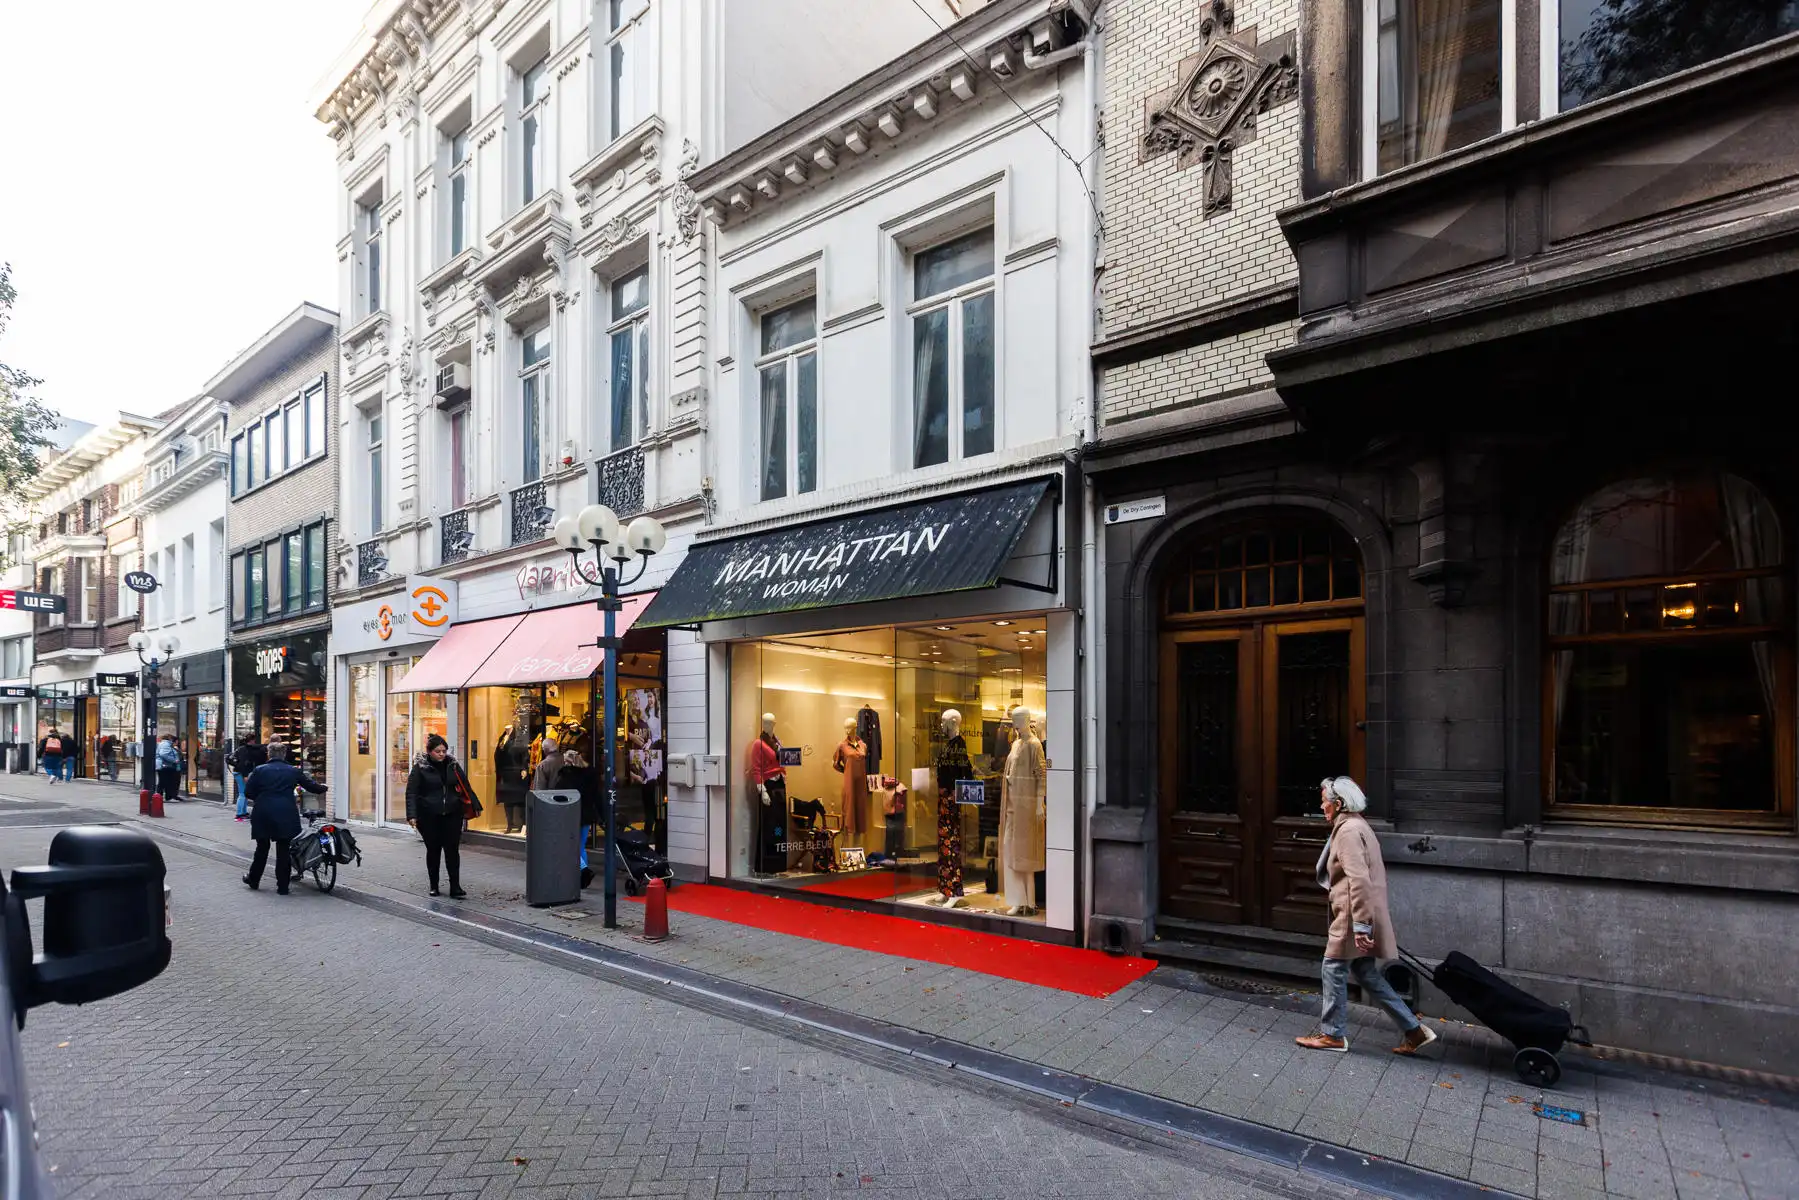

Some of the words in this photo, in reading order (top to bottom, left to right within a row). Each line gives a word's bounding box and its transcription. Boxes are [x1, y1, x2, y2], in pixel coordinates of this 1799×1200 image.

[714, 523, 951, 587] MANHATTAN
[129, 575, 153, 587] ms
[516, 552, 597, 601] paprika
[762, 573, 849, 599] WOMAN
[24, 596, 54, 609] WE
[363, 618, 379, 634] eyes
[255, 646, 283, 679] snipes
[507, 652, 592, 681] paprika
[105, 675, 127, 685] WE
[7, 688, 25, 696] WE
[775, 841, 804, 853] TERRE
